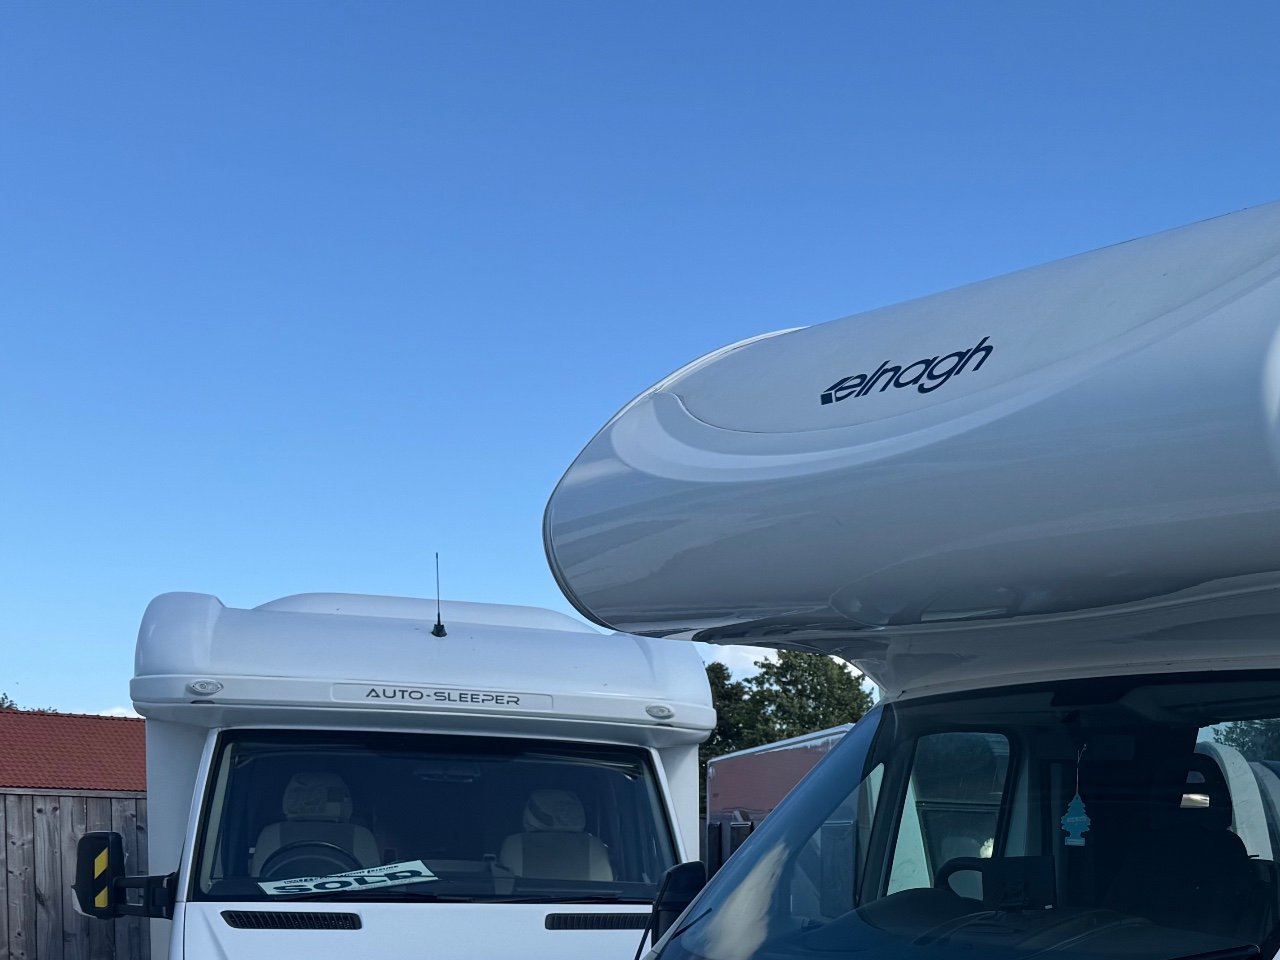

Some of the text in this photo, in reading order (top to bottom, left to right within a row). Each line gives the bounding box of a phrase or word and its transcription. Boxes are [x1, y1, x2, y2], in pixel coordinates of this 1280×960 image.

[820, 336, 994, 406] elnagh
[365, 688, 521, 706] AUTO-SLEEPER
[273, 869, 423, 894] SOLD
